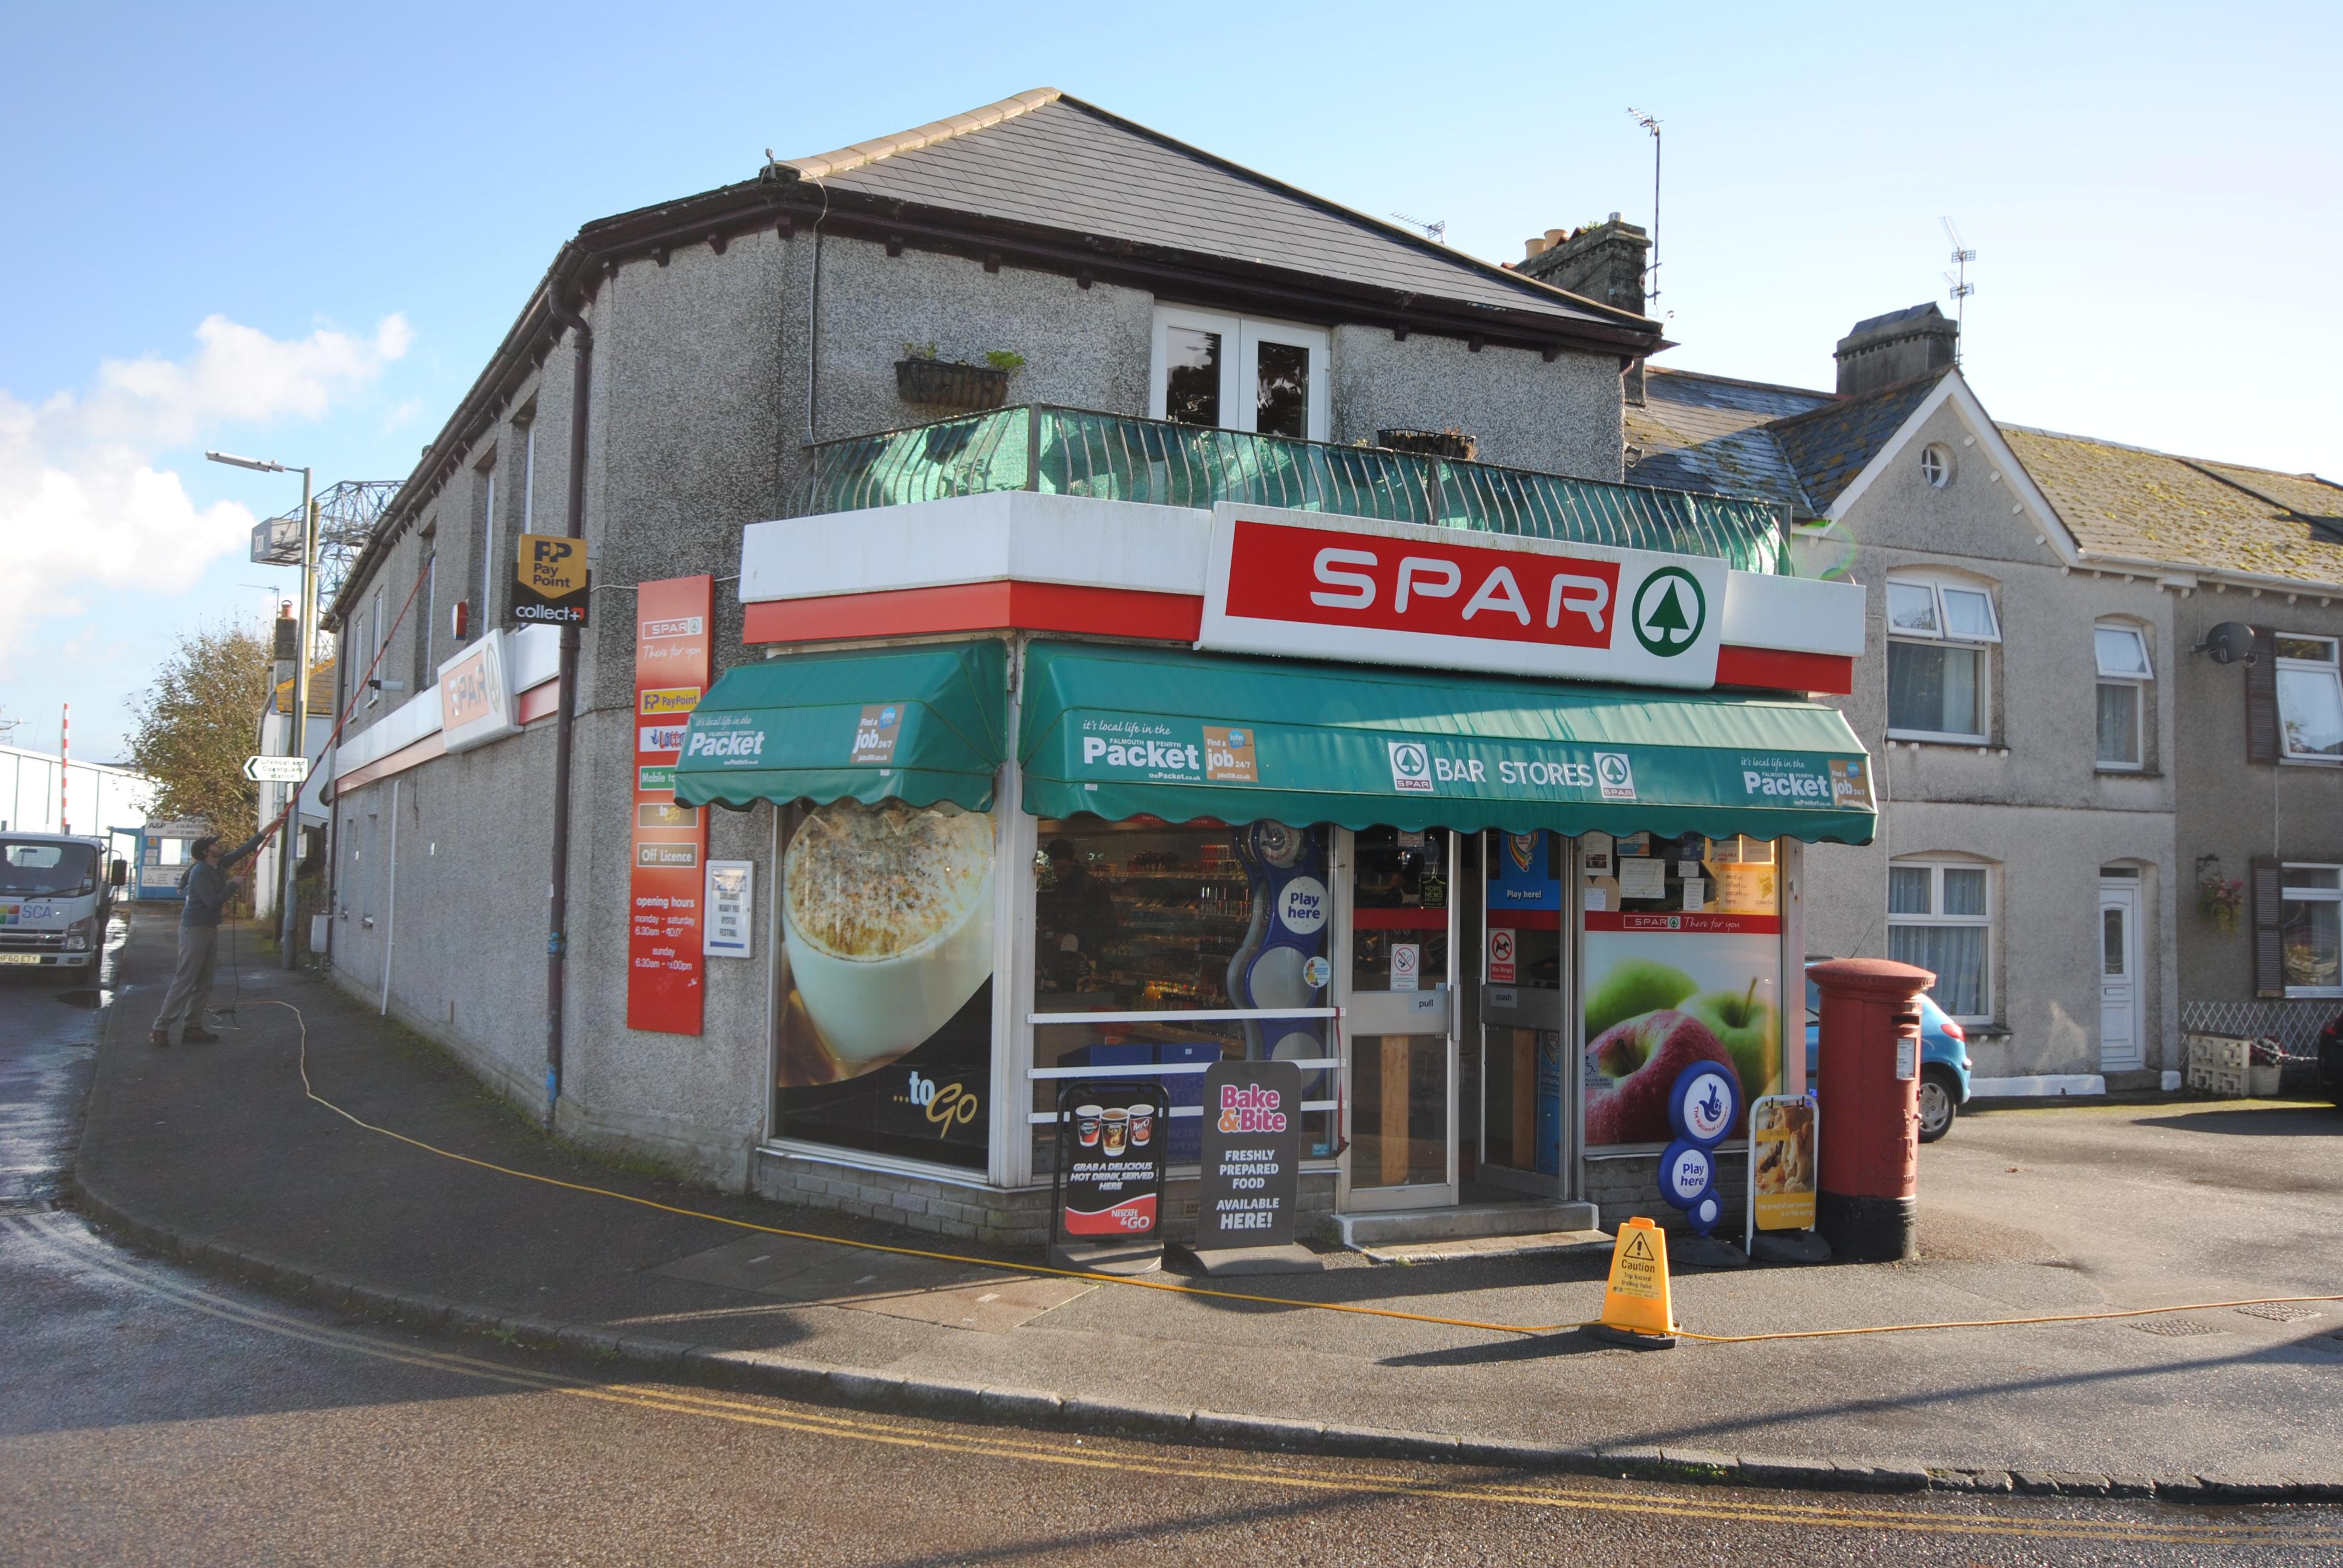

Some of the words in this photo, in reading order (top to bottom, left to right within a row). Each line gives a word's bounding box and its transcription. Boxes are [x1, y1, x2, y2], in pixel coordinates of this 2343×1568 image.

[534, 563, 559, 578] Pay
[533, 574, 571, 588] Point
[1309, 546, 1611, 633] SPAR
[652, 622, 687, 635] SPAR
[643, 645, 667, 660] There
[669, 644, 684, 660] for
[686, 647, 701, 661] you
[662, 695, 697, 708] PayPoint
[706, 716, 722, 725] local
[1083, 719, 1096, 730] it's
[1099, 720, 1123, 731] local
[1125, 722, 1141, 737] life
[1142, 724, 1153, 734] in
[1155, 724, 1172, 735] the
[688, 731, 765, 756] Packet
[852, 729, 879, 754] job
[1110, 737, 1144, 746] FALMOUTH
[1230, 733, 1244, 741] jobs
[1083, 736, 1200, 770] Packet
[1207, 748, 1234, 771] job
[1741, 757, 1751, 766] it's
[1752, 757, 1771, 766] local
[1771, 758, 1783, 771] life
[1783, 759, 1792, 768] in
[1793, 759, 1806, 768] the
[641, 771, 666, 783] Mobile
[1149, 772, 1201, 781] thePacket.co.uk
[1435, 758, 1487, 783] BAR
[1498, 761, 1593, 787] STORES
[1397, 779, 1430, 789] SPAR
[1743, 771, 1829, 797] Packet
[1833, 778, 1853, 798] job
[1604, 788, 1633, 797] SPAR
[641, 848, 657, 861] Off
[660, 849, 692, 862] Licence
[1291, 892, 1320, 908] Play
[1507, 890, 1522, 900] Play
[637, 896, 669, 909] opening
[671, 897, 695, 907] hours
[22, 905, 51, 919] SCA
[1288, 906, 1320, 919] here
[635, 915, 660, 925] monday
[667, 916, 695, 927] saturday
[1684, 916, 1707, 929] There
[1709, 917, 1723, 931] for
[1726, 923, 1740, 932] you
[635, 926, 660, 936] 6.30am
[652, 947, 676, 958] sunday
[635, 958, 660, 968] 6.30am
[1419, 999, 1433, 1009] pull
[1221, 1083, 1280, 1110] Bake
[926, 1082, 978, 1139] Go
[1696, 1119, 1716, 1132] National
[1225, 1149, 1275, 1161] FRESHLY
[1073, 1163, 1099, 1171] GRAB
[1098, 1163, 1106, 1171] A
[1107, 1162, 1153, 1171] DELICIOUS
[1219, 1163, 1279, 1175] PREPARED
[1683, 1163, 1704, 1175] Play
[1070, 1172, 1090, 1181] HOT
[1091, 1172, 1121, 1181] DRINK,
[1121, 1172, 1154, 1180] SERVED
[1233, 1177, 1265, 1189] FOOD
[1680, 1176, 1704, 1186] here
[1098, 1182, 1123, 1191] HERE
[1216, 1198, 1280, 1210] AVAILABLE
[1221, 1212, 1273, 1230] HERE!
[1622, 1259, 1655, 1273] Caution
[1622, 1279, 1639, 1288] trailing
